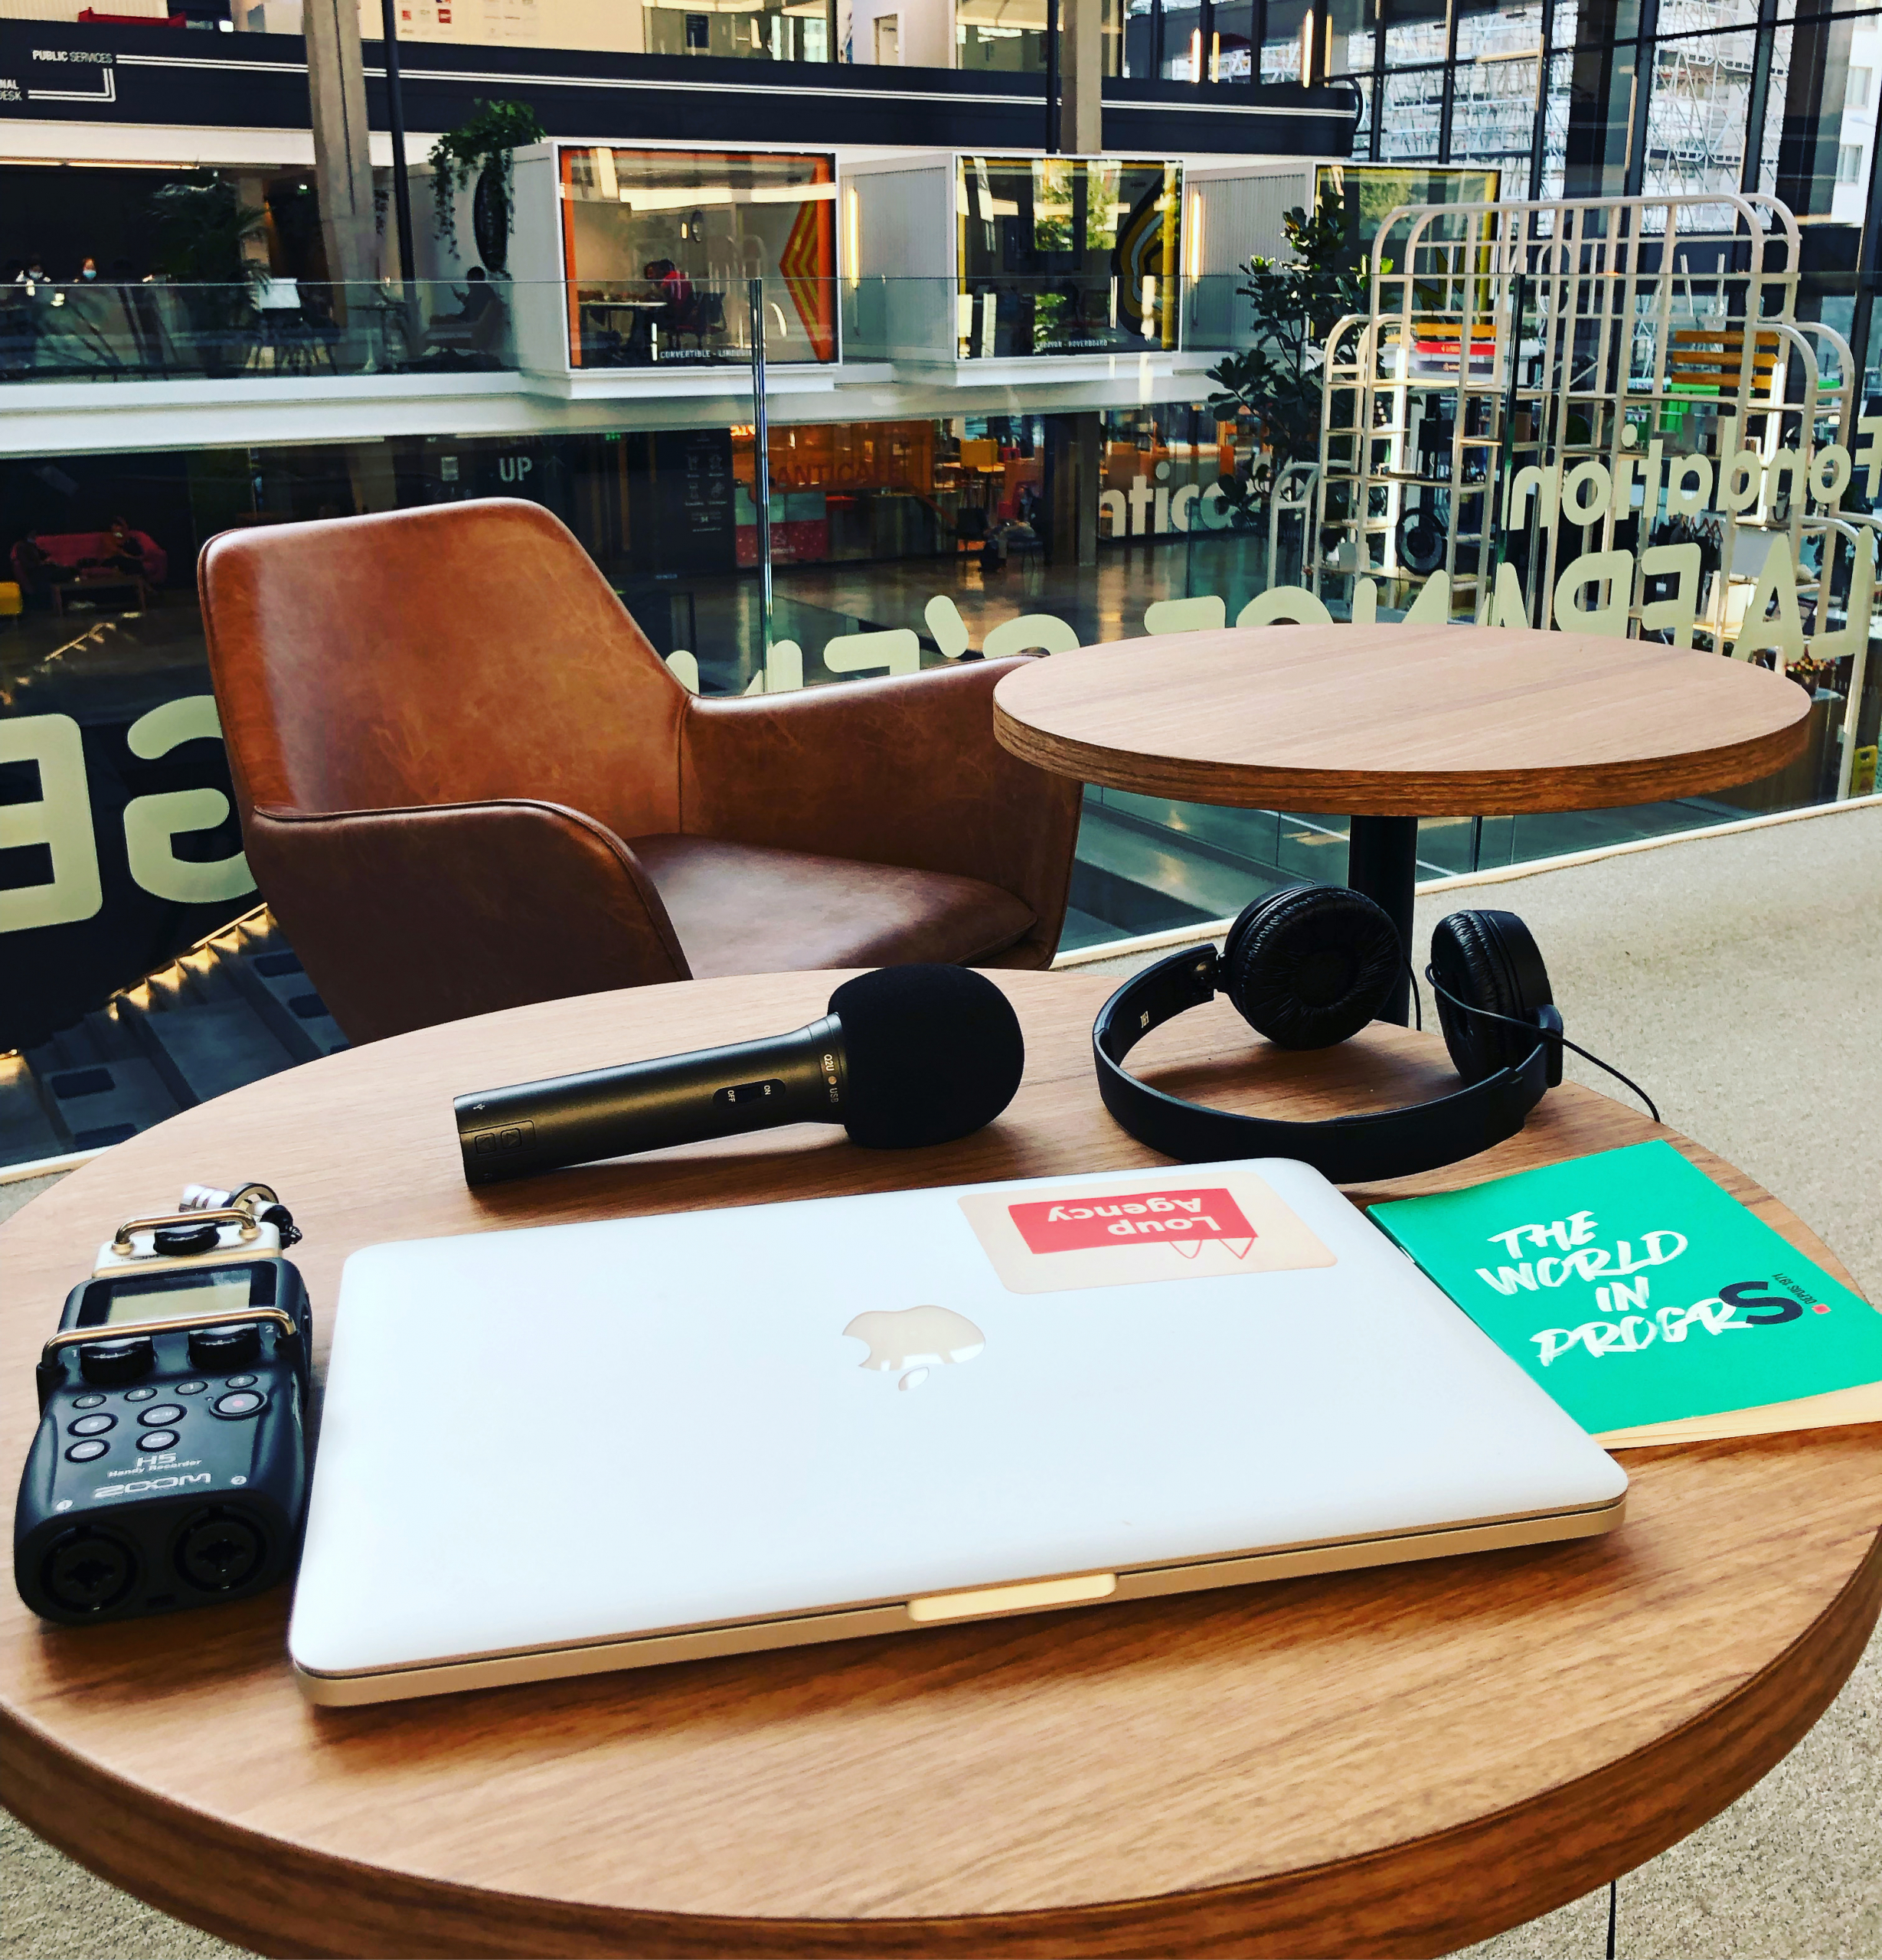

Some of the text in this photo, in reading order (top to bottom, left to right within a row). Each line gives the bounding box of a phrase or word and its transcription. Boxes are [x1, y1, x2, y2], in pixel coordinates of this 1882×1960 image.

[32, 50, 113, 64] PUBLIC SERVICES
[660, 349, 711, 358] CONVERTIBLE
[498, 456, 534, 482] UP
[823, 1054, 835, 1072] Q2U
[727, 1089, 736, 1102] OFF
[763, 1085, 772, 1096] ON
[829, 1087, 839, 1103] USB
[1047, 1197, 1203, 1222] Agency
[1107, 1215, 1222, 1236] Loup
[1487, 1210, 1599, 1259] THE
[1475, 1230, 1688, 1295] WORLD
[1595, 1276, 1650, 1312] IN
[1787, 1285, 1818, 1305] DEPUIS
[107, 1459, 202, 1478] Handy Recorder
[136, 1452, 177, 1467] H5
[93, 1472, 212, 1499] ZOOM
